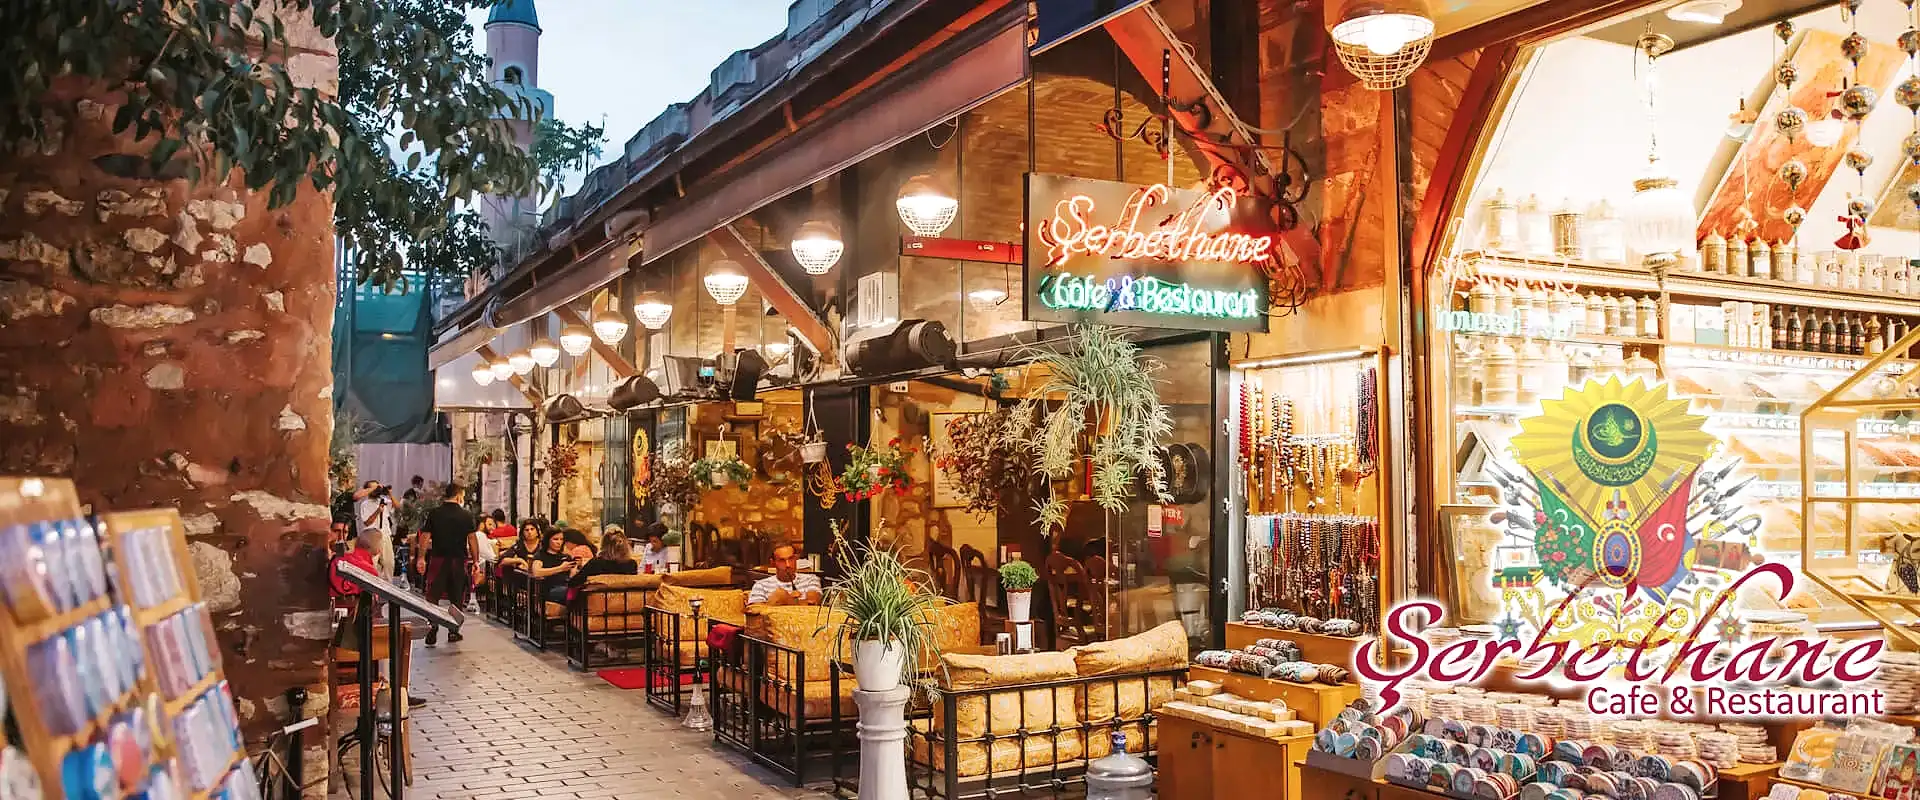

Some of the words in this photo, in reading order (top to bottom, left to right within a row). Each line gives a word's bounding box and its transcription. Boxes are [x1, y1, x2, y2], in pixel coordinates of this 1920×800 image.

[1039, 184, 1272, 267] Şerbethane
[1045, 272, 1108, 310] Cafe
[1114, 275, 1137, 311] &
[1143, 276, 1259, 318] Restaurant
